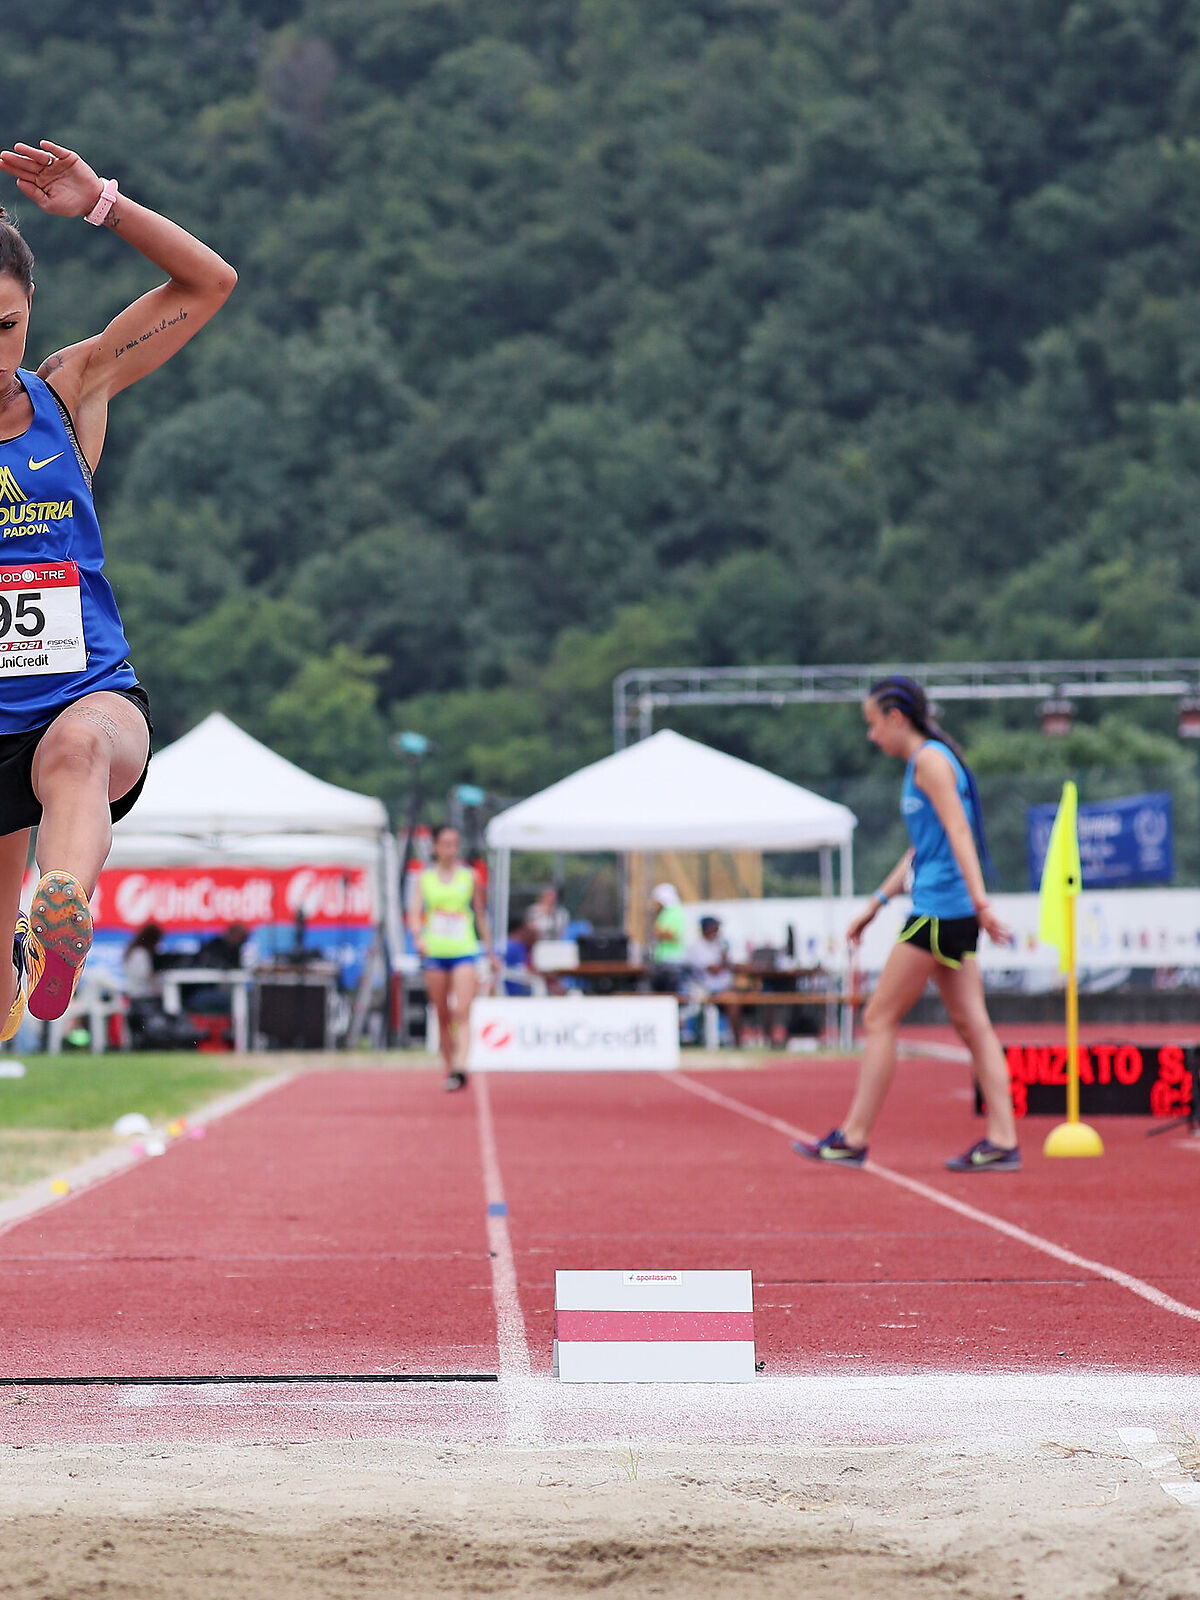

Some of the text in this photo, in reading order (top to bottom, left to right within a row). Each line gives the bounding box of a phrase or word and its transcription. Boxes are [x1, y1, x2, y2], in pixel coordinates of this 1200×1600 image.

[3, 523, 50, 539] PADOVA
[11, 640, 41, 651] 2021
[519, 1022, 658, 1048] UniCredit
